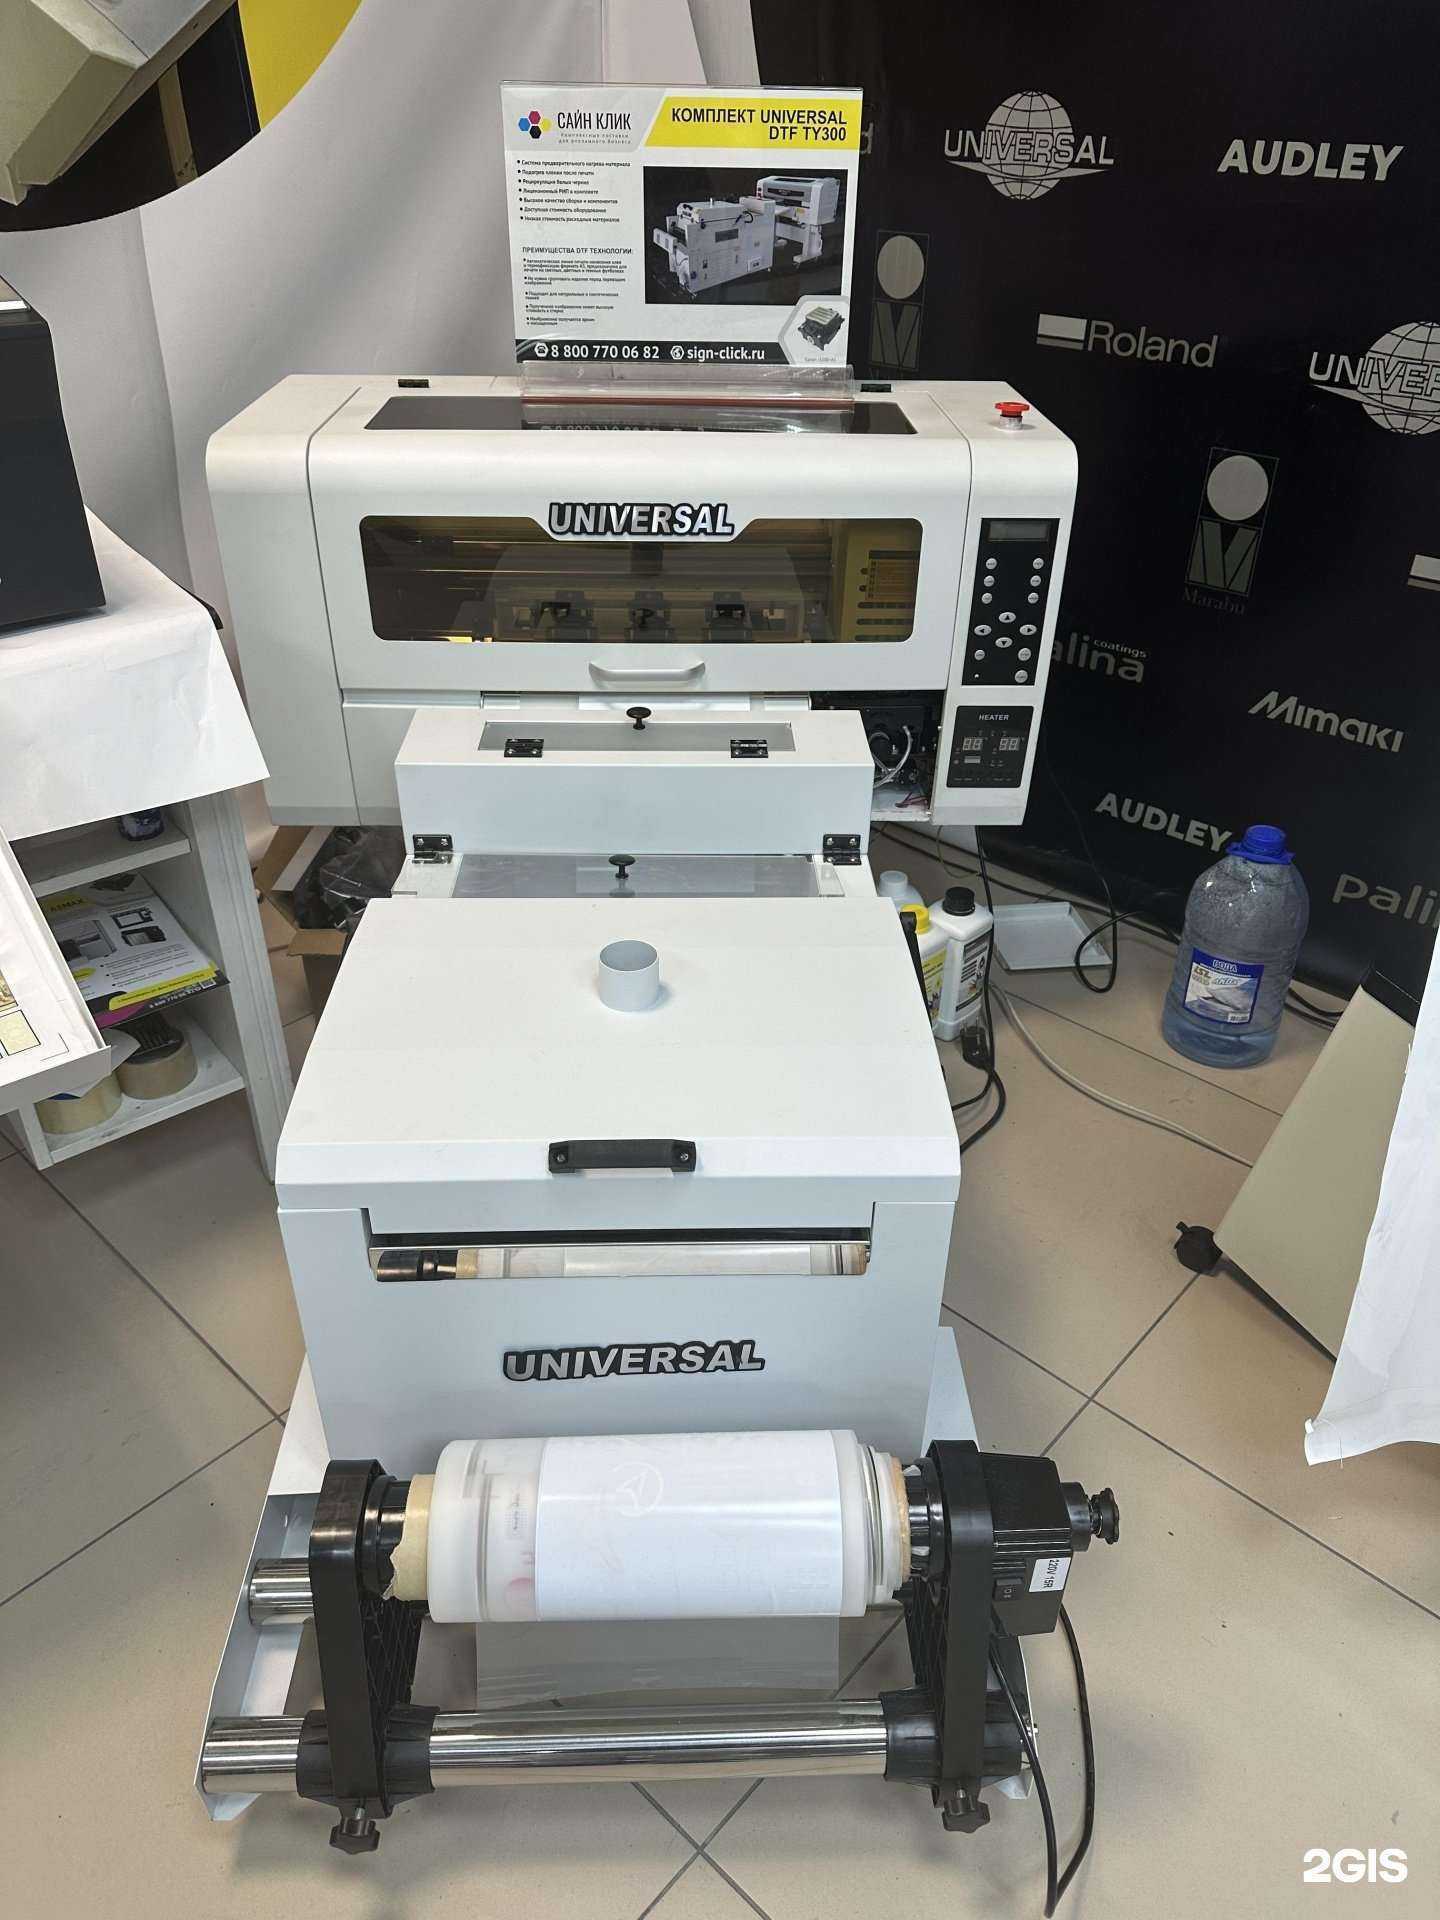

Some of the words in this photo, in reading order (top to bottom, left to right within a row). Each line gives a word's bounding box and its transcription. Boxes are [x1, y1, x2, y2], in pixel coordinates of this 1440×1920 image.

[558, 109, 591, 129] САЙН
[597, 113, 631, 130] КЛИК
[672, 108, 755, 122] КОМПЛЕКТ
[761, 110, 846, 124] UNIVERSAL
[770, 126, 797, 140] DTF
[803, 126, 846, 141] TY300
[944, 128, 1115, 167] UNIVERSAL
[1217, 138, 1405, 182] AUDLEY
[551, 346, 559, 358] 8
[564, 346, 588, 358] 800
[593, 346, 618, 358] 770
[621, 347, 639, 359] 06
[643, 347, 660, 359] 82
[687, 346, 765, 361] sign-click.ru
[1087, 319, 1220, 369] Roland
[549, 503, 734, 535] UNIVERSAL
[1094, 639, 1147, 658] coatings
[1095, 792, 1234, 853] AUDLEY
[503, 1340, 766, 1382] UNIVERSAL
